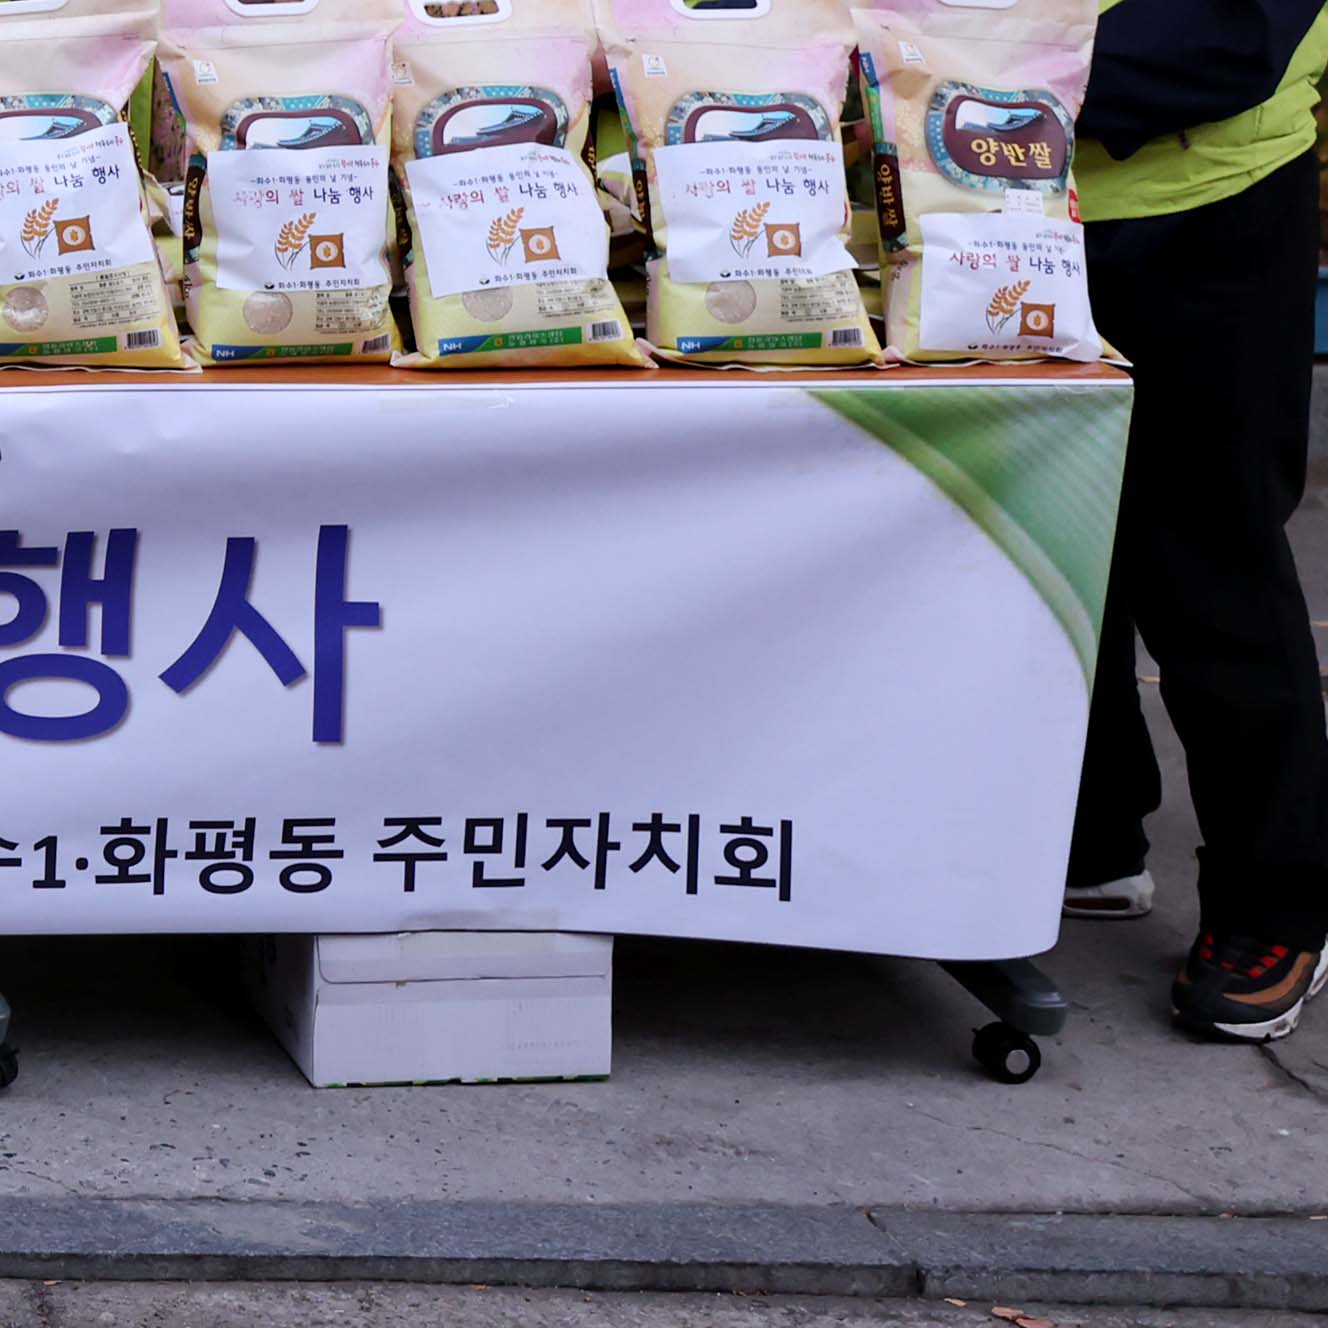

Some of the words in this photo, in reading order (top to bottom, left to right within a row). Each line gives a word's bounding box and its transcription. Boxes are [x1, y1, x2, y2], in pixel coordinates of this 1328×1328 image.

[971, 136, 1052, 169] 양반쌀
[54, 173, 85, 189] 나눔
[92, 164, 120, 185] 행사
[313, 187, 342, 204] 나눔
[349, 186, 374, 204] 행사
[519, 182, 548, 199] 나눔
[766, 178, 795, 195] 나눔
[803, 178, 830, 197] 행사
[950, 252, 997, 270] 사랑의
[1029, 256, 1056, 274] 나눔
[216, 349, 236, 358] NH
[370, 810, 794, 902] 주민자치회
